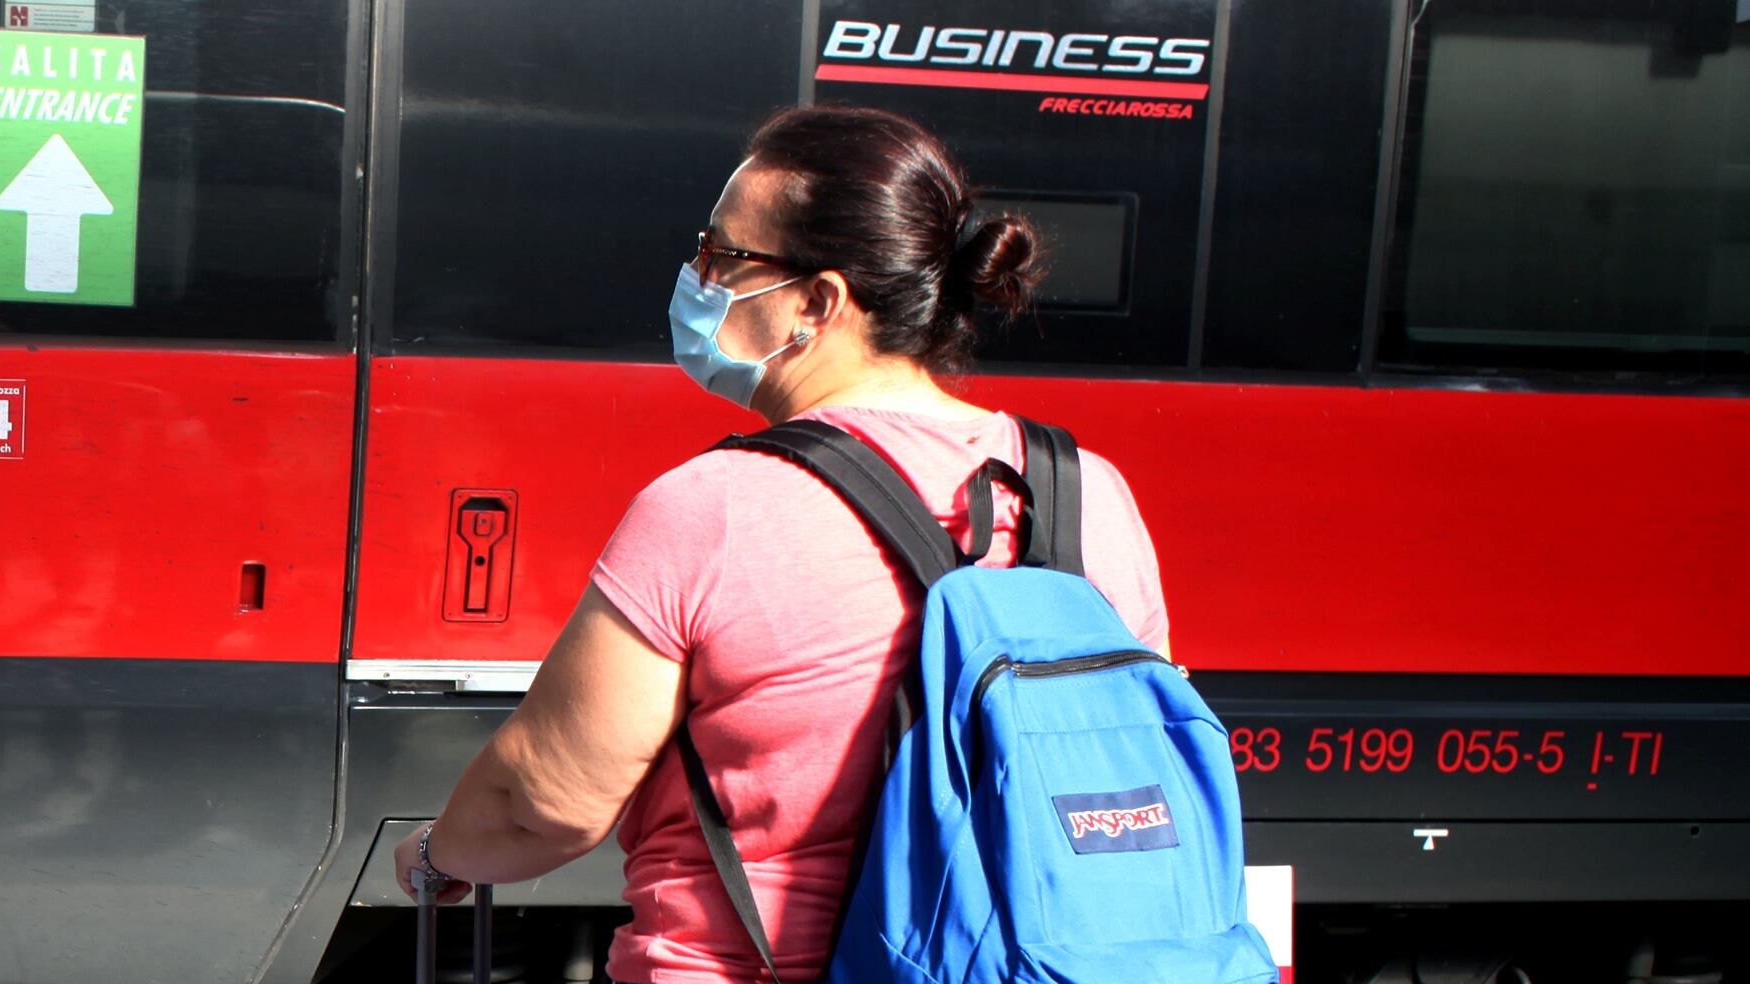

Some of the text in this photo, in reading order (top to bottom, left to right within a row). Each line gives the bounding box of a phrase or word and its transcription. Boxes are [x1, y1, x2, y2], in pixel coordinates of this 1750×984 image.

[823, 20, 1211, 75] BUSINESS
[1038, 97, 1193, 119] FRECCIAROSSA
[1305, 727, 1414, 773] 5199
[1436, 729, 1566, 774] 055-5
[1067, 802, 1170, 839] JANSPORT
